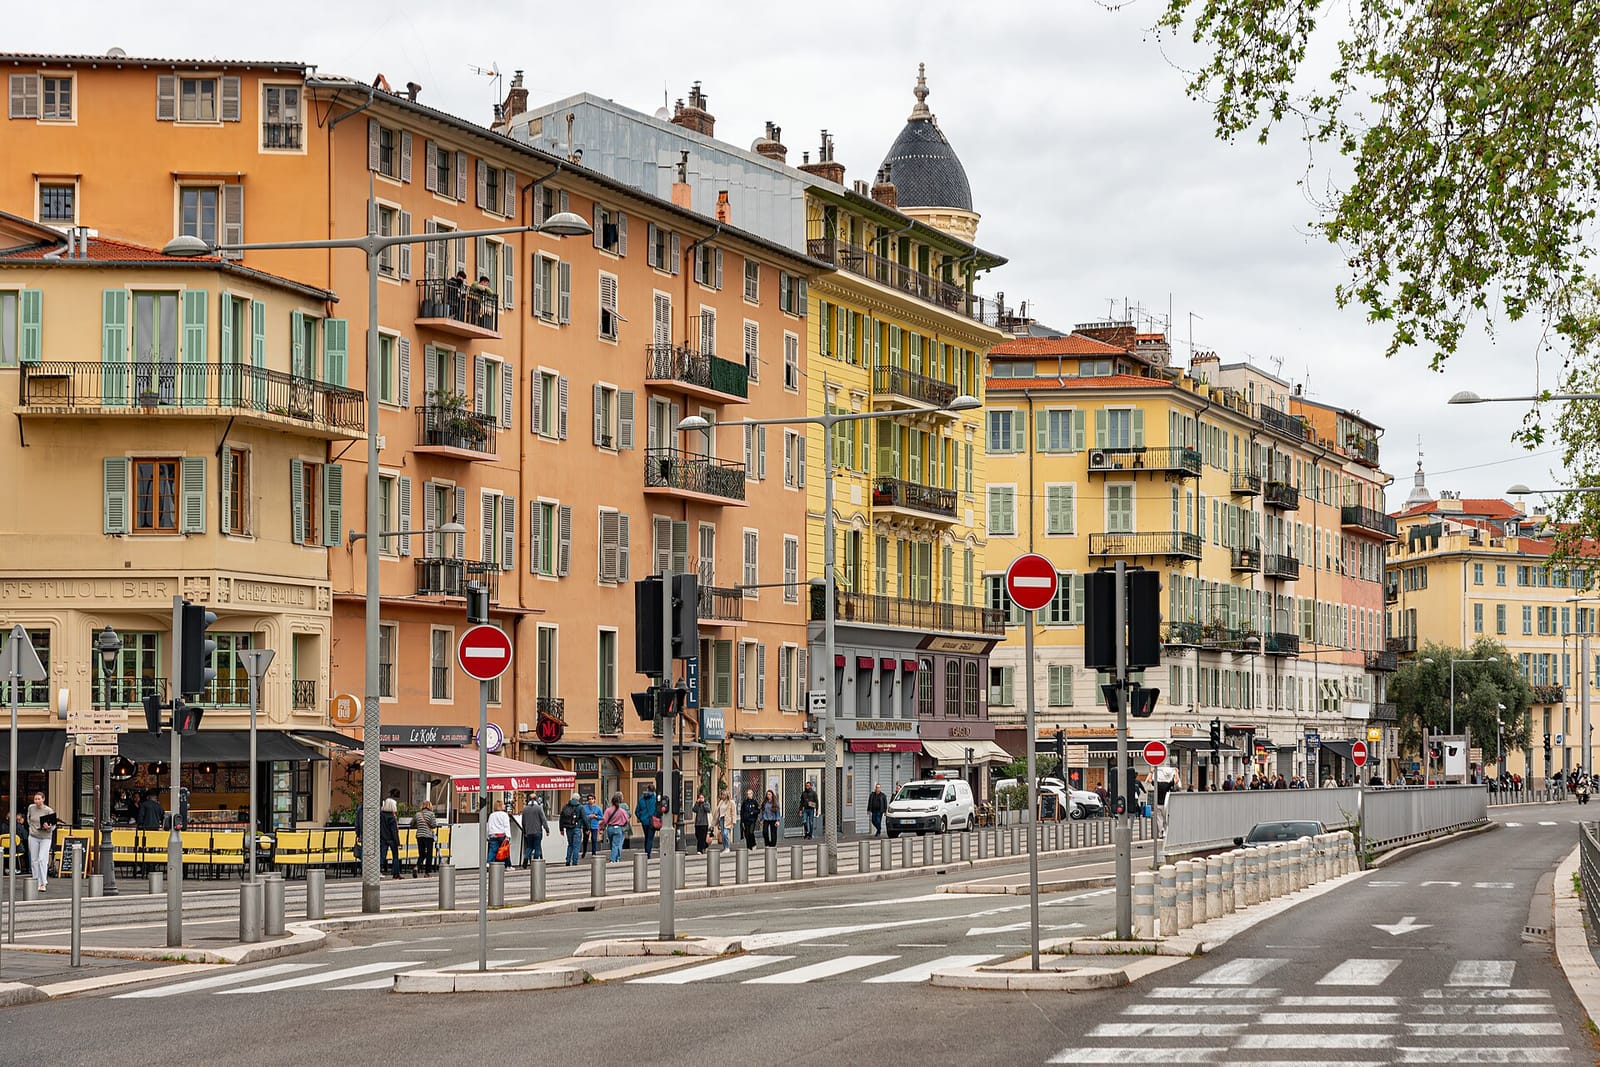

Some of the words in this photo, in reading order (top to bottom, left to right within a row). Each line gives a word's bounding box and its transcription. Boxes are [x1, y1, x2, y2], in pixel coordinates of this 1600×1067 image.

[40, 581, 115, 599] TIVOLI
[122, 581, 168, 598] BAR
[237, 583, 267, 602] CHEZ
[270, 586, 305, 605] EMILE
[688, 656, 697, 703] TEL
[410, 728, 419, 742] Le
[420, 727, 439, 744] Kobé
